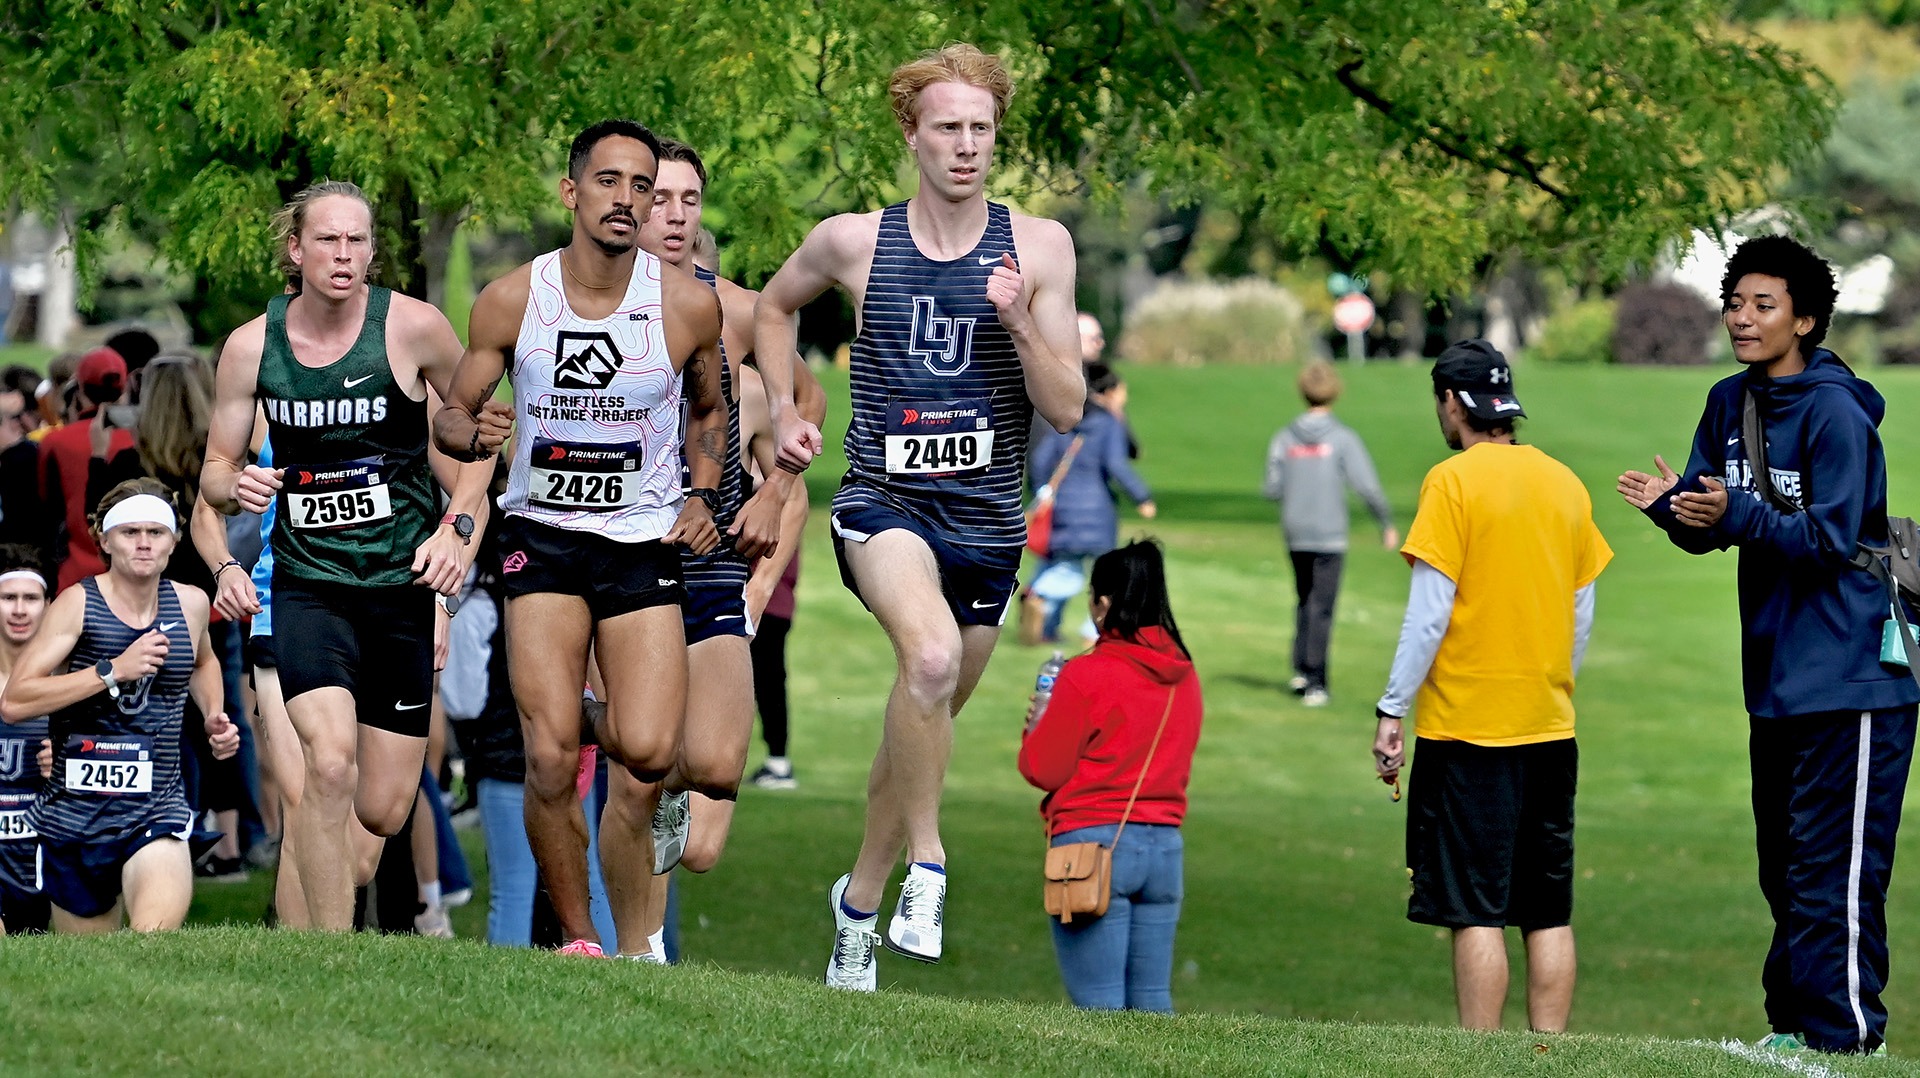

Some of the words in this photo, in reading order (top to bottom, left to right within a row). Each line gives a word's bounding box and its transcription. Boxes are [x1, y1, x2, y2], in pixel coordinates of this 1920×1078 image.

[629, 313, 650, 321] BOA
[908, 295, 977, 377] LU
[550, 394, 625, 408] DRIFTLESS
[265, 396, 388, 428] WARRIORS
[527, 402, 587, 421] DISTANCE
[592, 407, 650, 422] PROJECT
[921, 408, 979, 420] PRIMETIME
[568, 450, 627, 459] PRIMETIME
[903, 435, 978, 470] 2449
[314, 466, 369, 481] PRIMETIME
[546, 472, 624, 504] 2426
[301, 490, 376, 525] 2595
[95, 742, 141, 751] PRIMETIME
[80, 763, 139, 789] 2452
